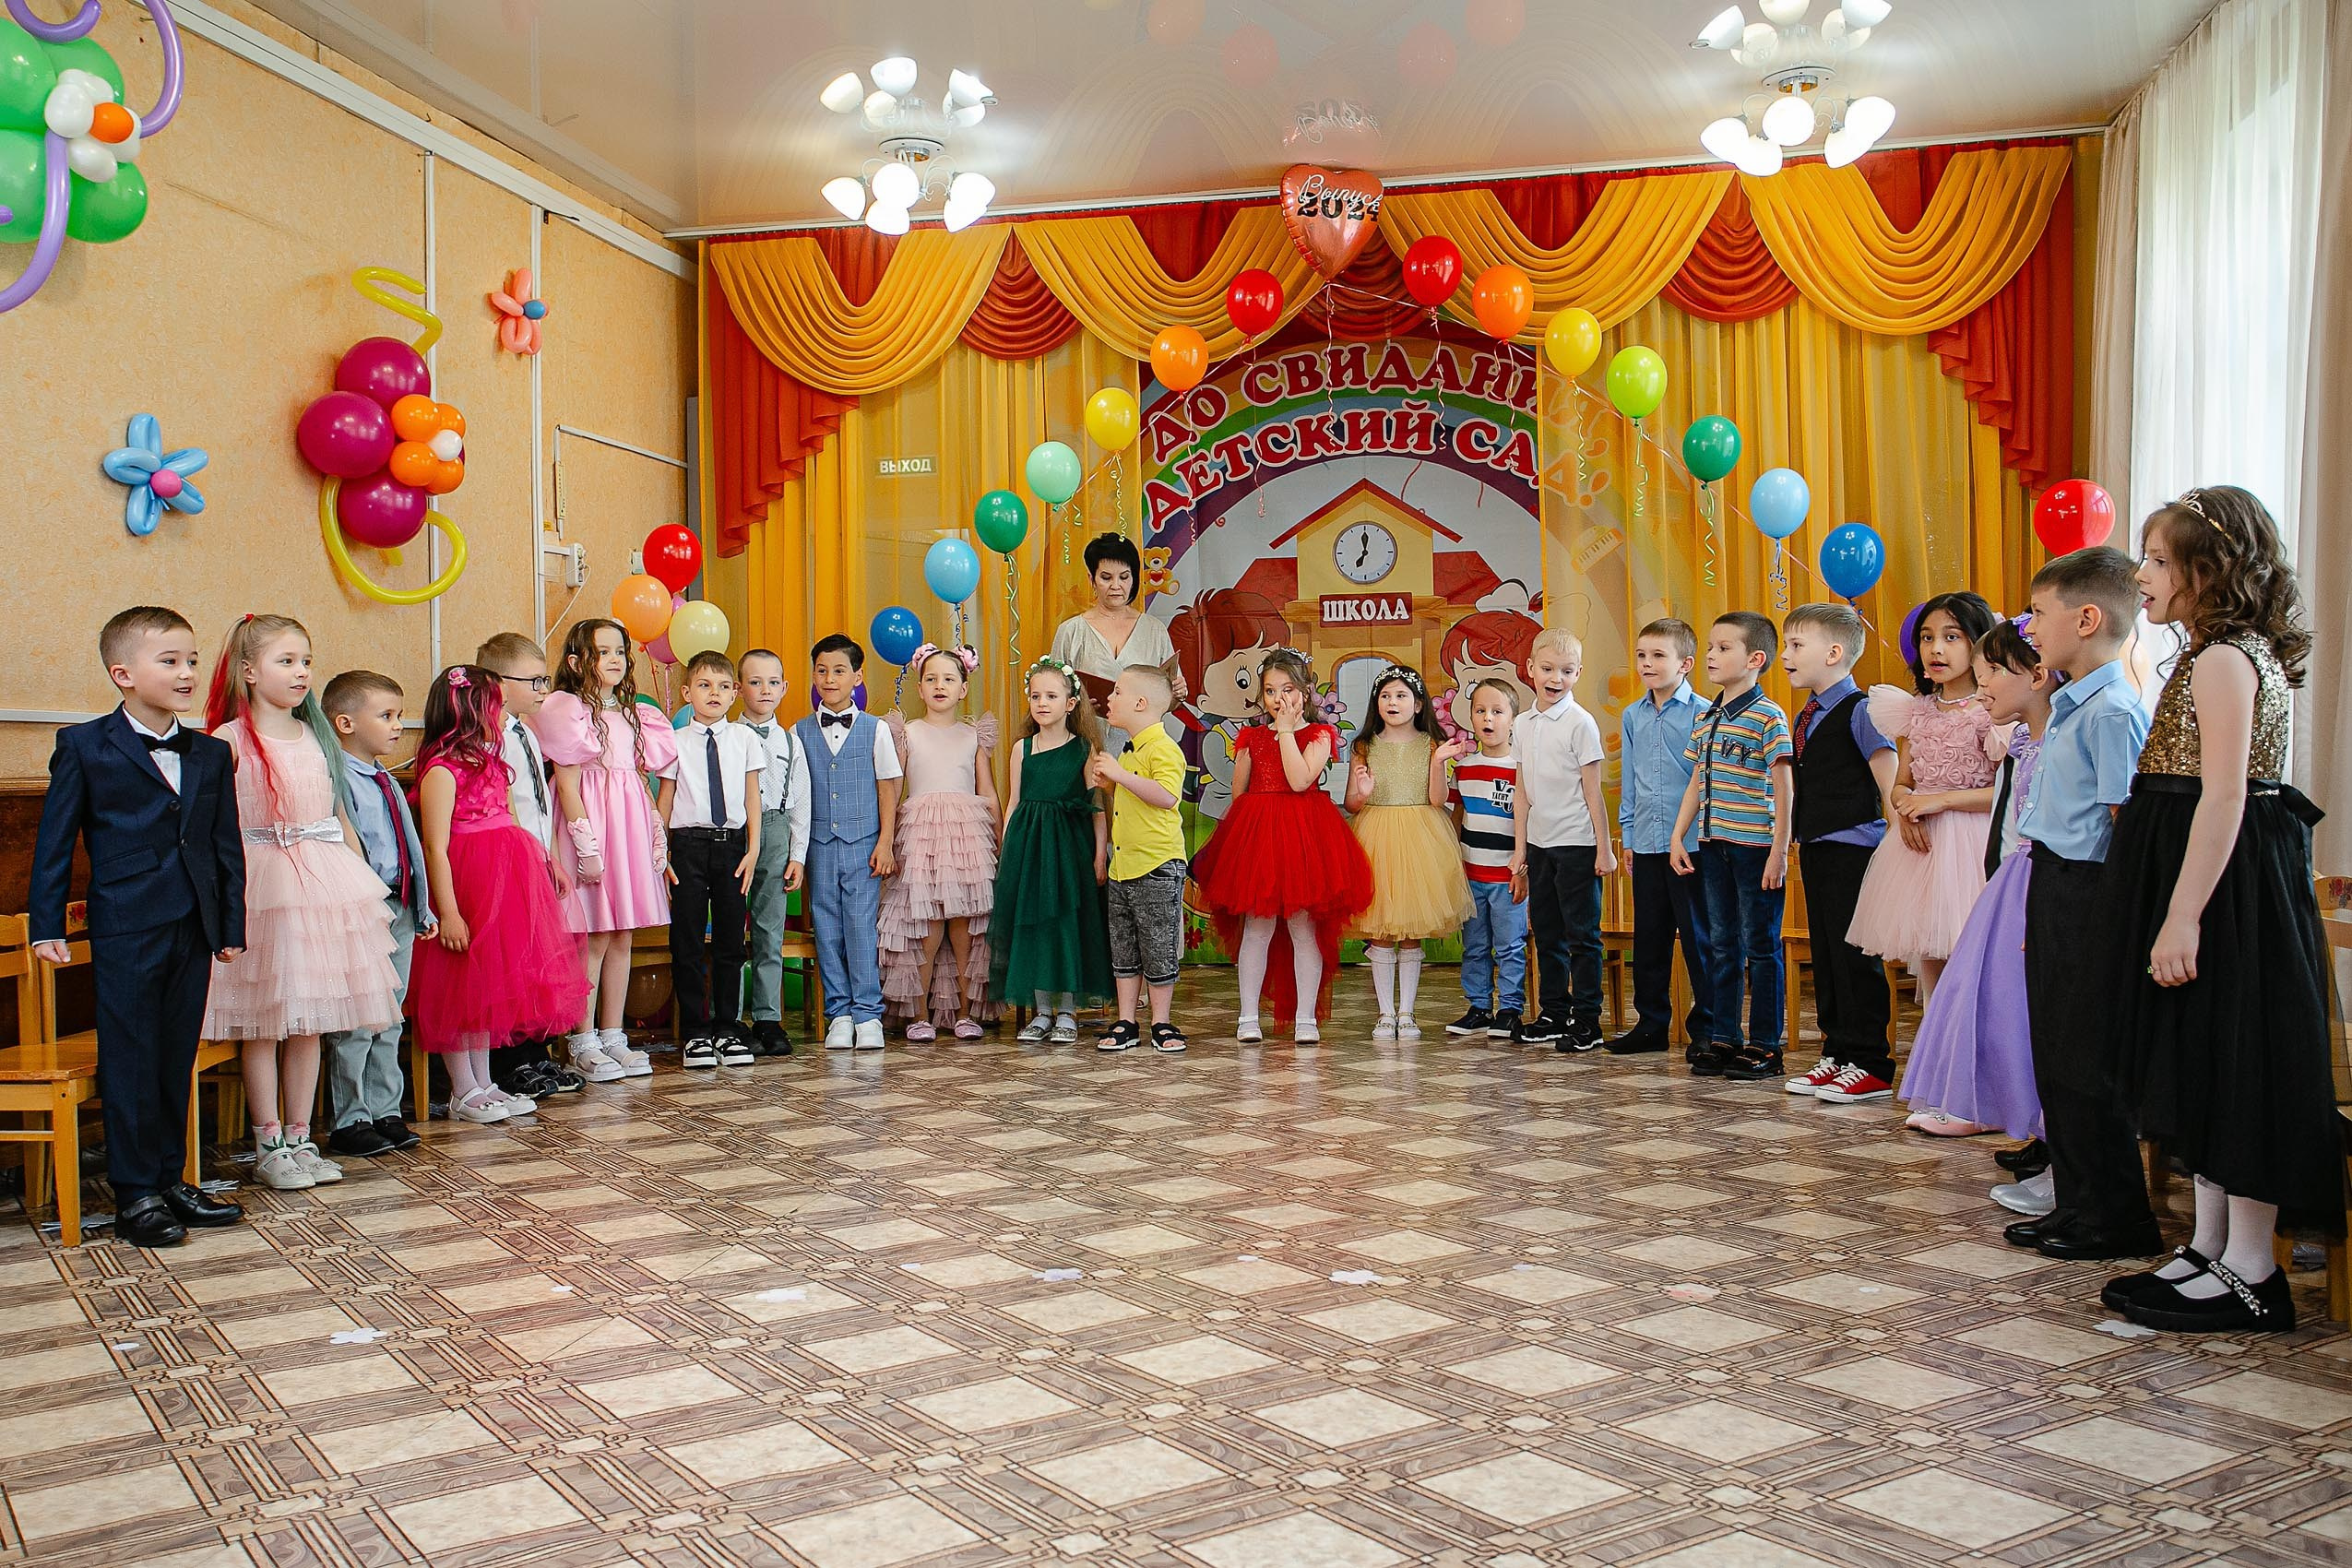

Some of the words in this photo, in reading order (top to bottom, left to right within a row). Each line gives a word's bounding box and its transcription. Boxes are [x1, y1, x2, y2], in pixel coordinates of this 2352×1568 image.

[1297, 191, 1379, 221] 2024
[1149, 385, 1229, 464] ДО
[880, 458, 932, 472] ВЫХОД
[1144, 399, 1439, 532] ДЕТСКИЙ
[1323, 599, 1409, 622] ШКОЛА
